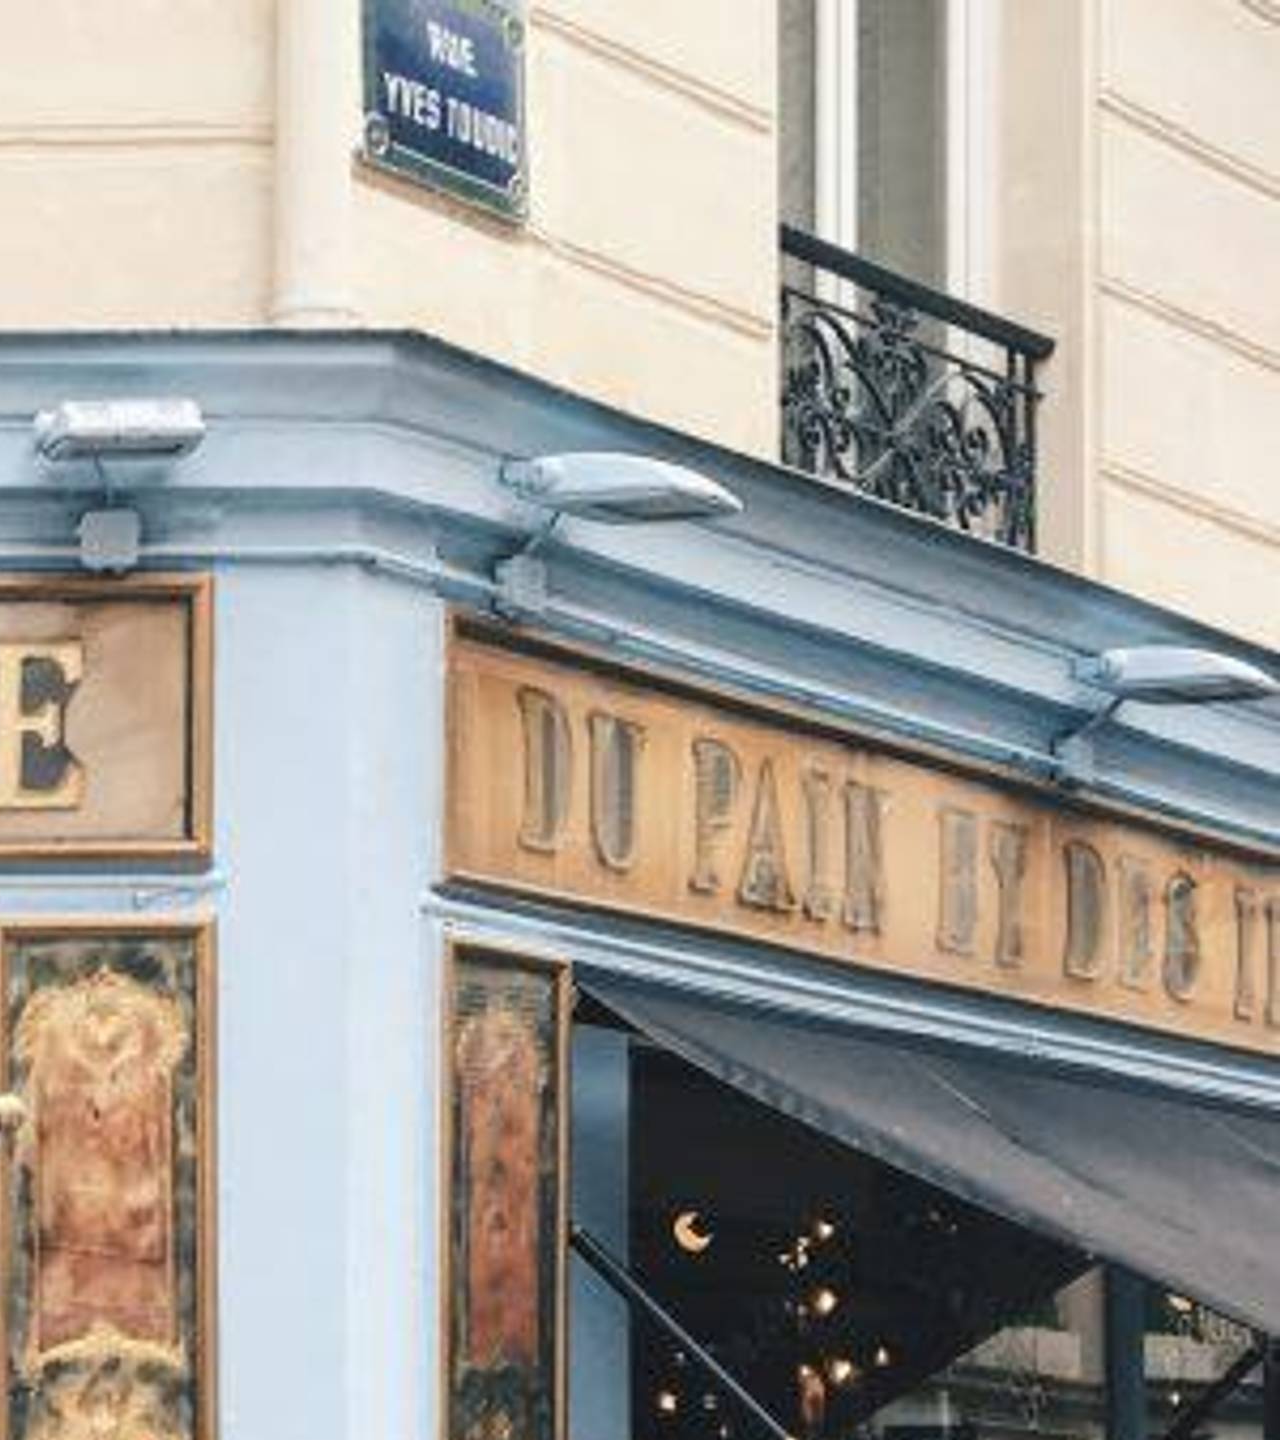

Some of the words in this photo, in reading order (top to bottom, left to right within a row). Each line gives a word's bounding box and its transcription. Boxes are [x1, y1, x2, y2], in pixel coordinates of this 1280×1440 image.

[426, 20, 478, 78] RUE
[383, 71, 440, 130] YVES
[515, 685, 647, 874] DU
[686, 736, 896, 938] PAIN
